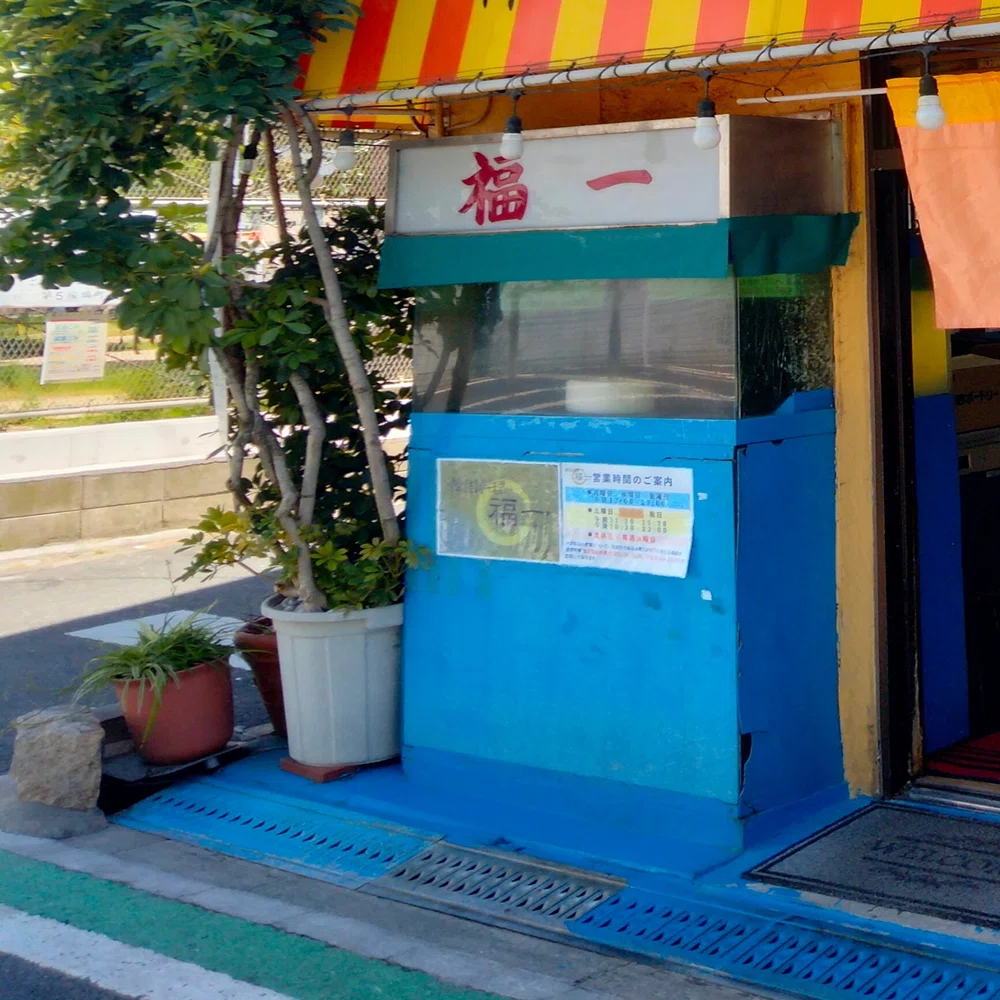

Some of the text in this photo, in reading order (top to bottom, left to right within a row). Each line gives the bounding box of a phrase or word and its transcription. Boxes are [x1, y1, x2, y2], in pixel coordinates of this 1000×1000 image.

[458, 152, 653, 225] 福一
[593, 473, 673, 487] 営業時間のご案内
